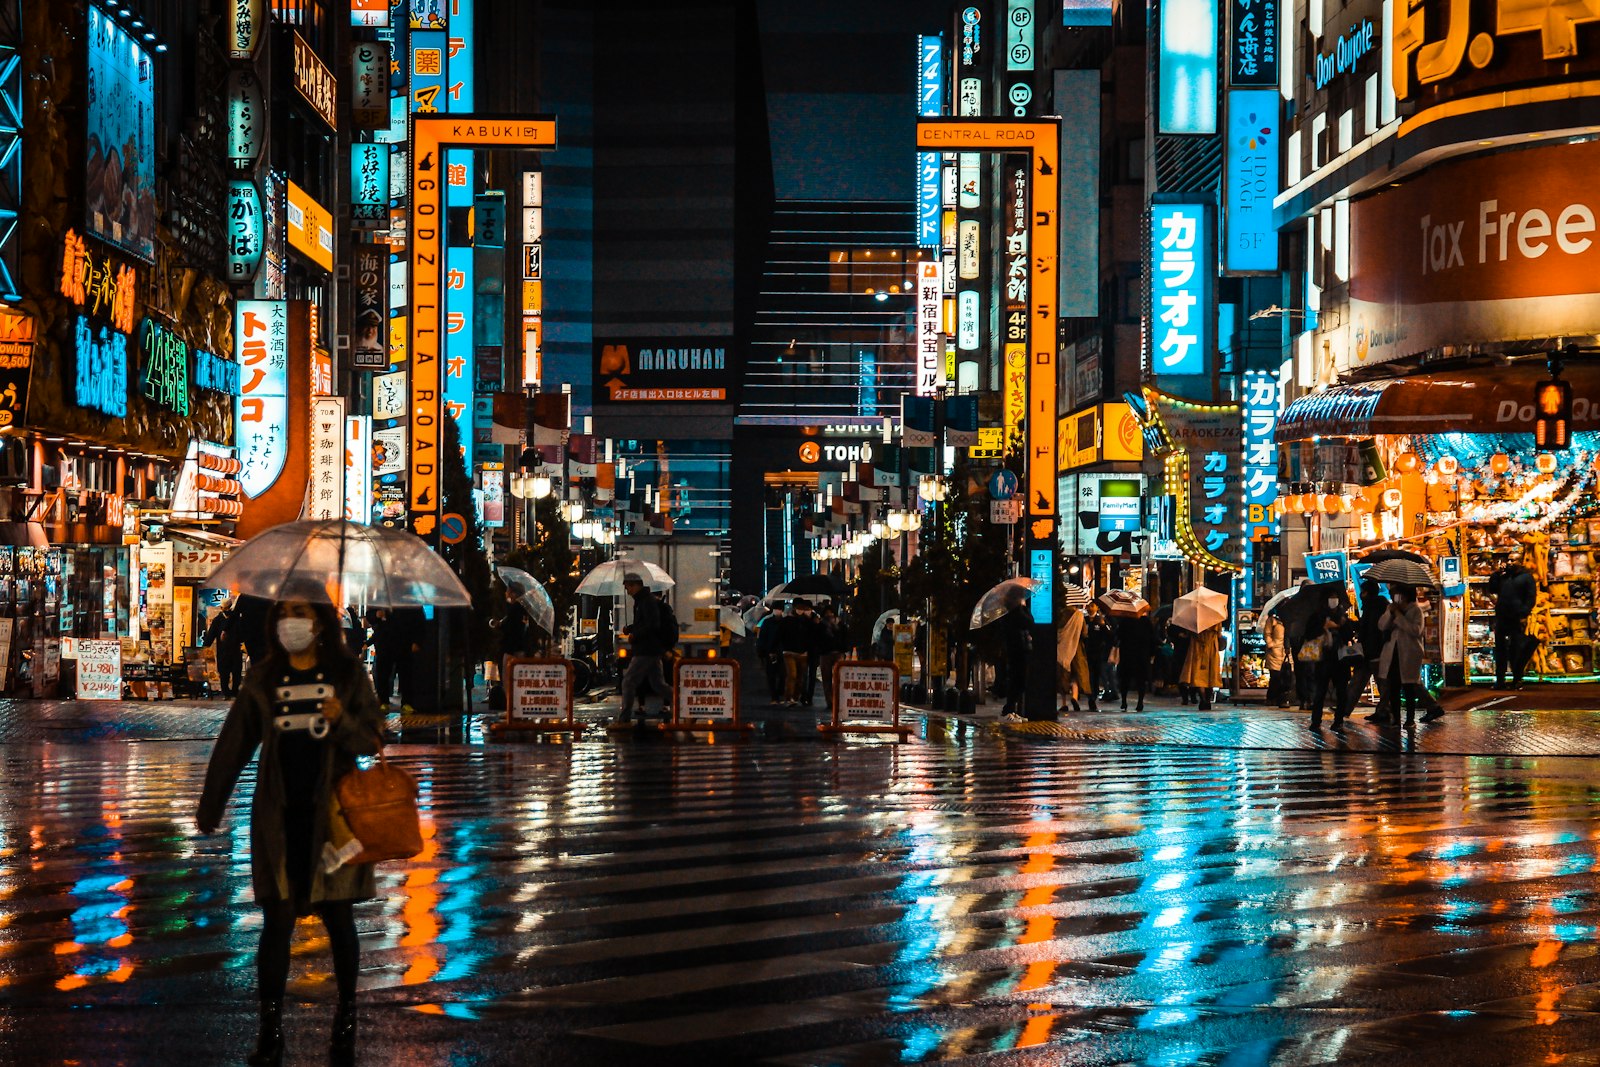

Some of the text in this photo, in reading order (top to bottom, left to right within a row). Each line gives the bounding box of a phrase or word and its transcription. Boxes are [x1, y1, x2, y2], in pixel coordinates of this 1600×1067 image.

[236, 0, 251, 49] み焼き
[361, 12, 378, 25] 4F
[1015, 13, 1027, 59] 8F 5F
[417, 51, 438, 72] 薬
[923, 45, 939, 101] 747
[1316, 18, 1373, 90] Don Quijote
[239, 91, 252, 154] とらそば
[414, 85, 442, 113] マ
[924, 129, 1035, 140] CENTRAL ROAD
[234, 160, 249, 169] 1F
[360, 146, 380, 203] お好み焼
[1240, 155, 1253, 214] STAGE
[1255, 156, 1267, 204] IDOL
[230, 198, 254, 256] かっぱ
[1239, 232, 1266, 250] 5F
[1421, 199, 1596, 276] Tax Free
[233, 263, 250, 274] B1
[359, 252, 379, 306] 海の家
[1160, 211, 1198, 367] カラオケ
[0, 313, 34, 339] KI
[270, 304, 287, 370] 大衆酒場
[416, 179, 435, 476] GODZILLA ROAD
[447, 267, 467, 421] カラオケ
[1036, 210, 1055, 459] ゴジラロード
[0, 356, 30, 368] 2,500
[240, 311, 268, 423] トラノコ
[638, 348, 725, 370] MARUHAN
[1496, 400, 1537, 422] Do
[241, 432, 264, 481] やきとん
[260, 422, 281, 471] やきとり
[1247, 377, 1278, 499] カラオケ
[1102, 502, 1137, 510] FamilyMart
[1203, 450, 1230, 551] カラオケ
[1248, 503, 1276, 523] B1
[177, 551, 222, 563] トラノコ
